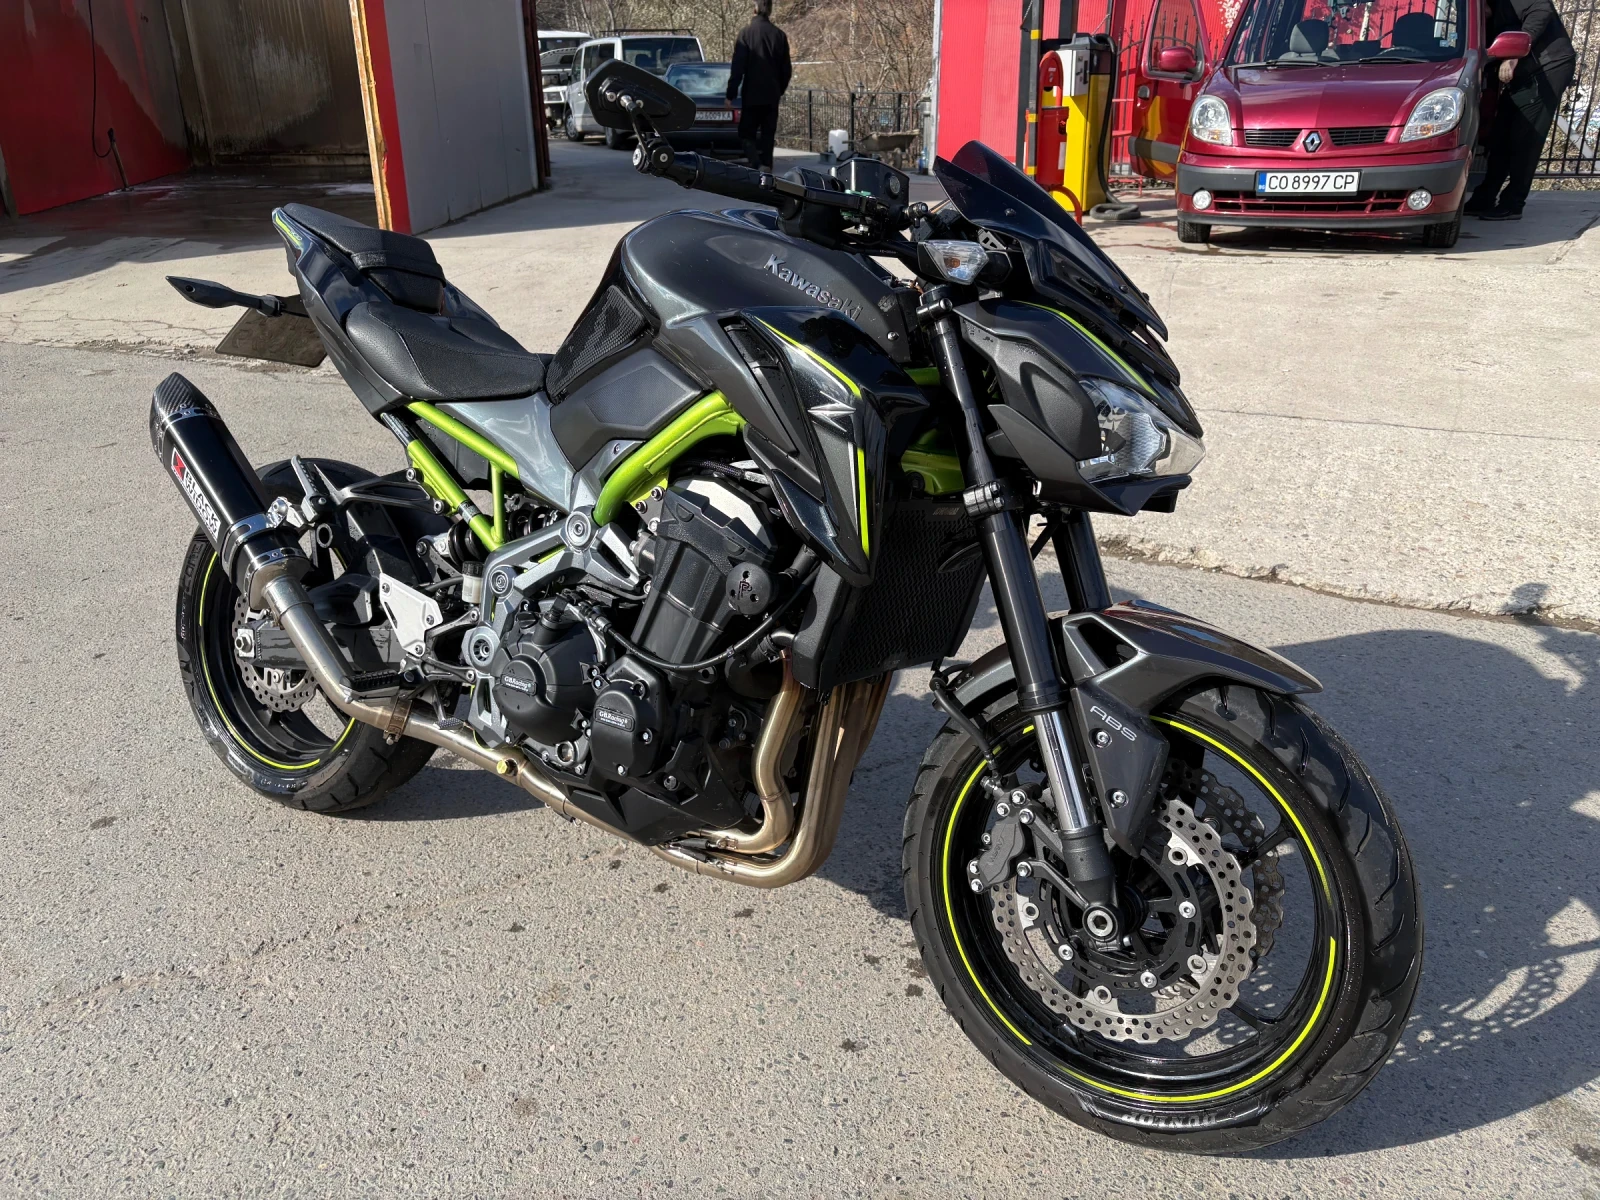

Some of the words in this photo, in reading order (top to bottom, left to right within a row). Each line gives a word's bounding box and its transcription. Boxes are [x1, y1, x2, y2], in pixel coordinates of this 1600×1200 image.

[1268, 175, 1289, 190] CO
[1291, 174, 1331, 190] 8997
[1333, 174, 1355, 190] CP
[763, 253, 863, 322] Kawasaki
[184, 470, 219, 525] BLACK
[184, 480, 217, 536] WIDOW
[1090, 705, 1138, 741] ABS
[1121, 1111, 1218, 1127] DUNLOP
